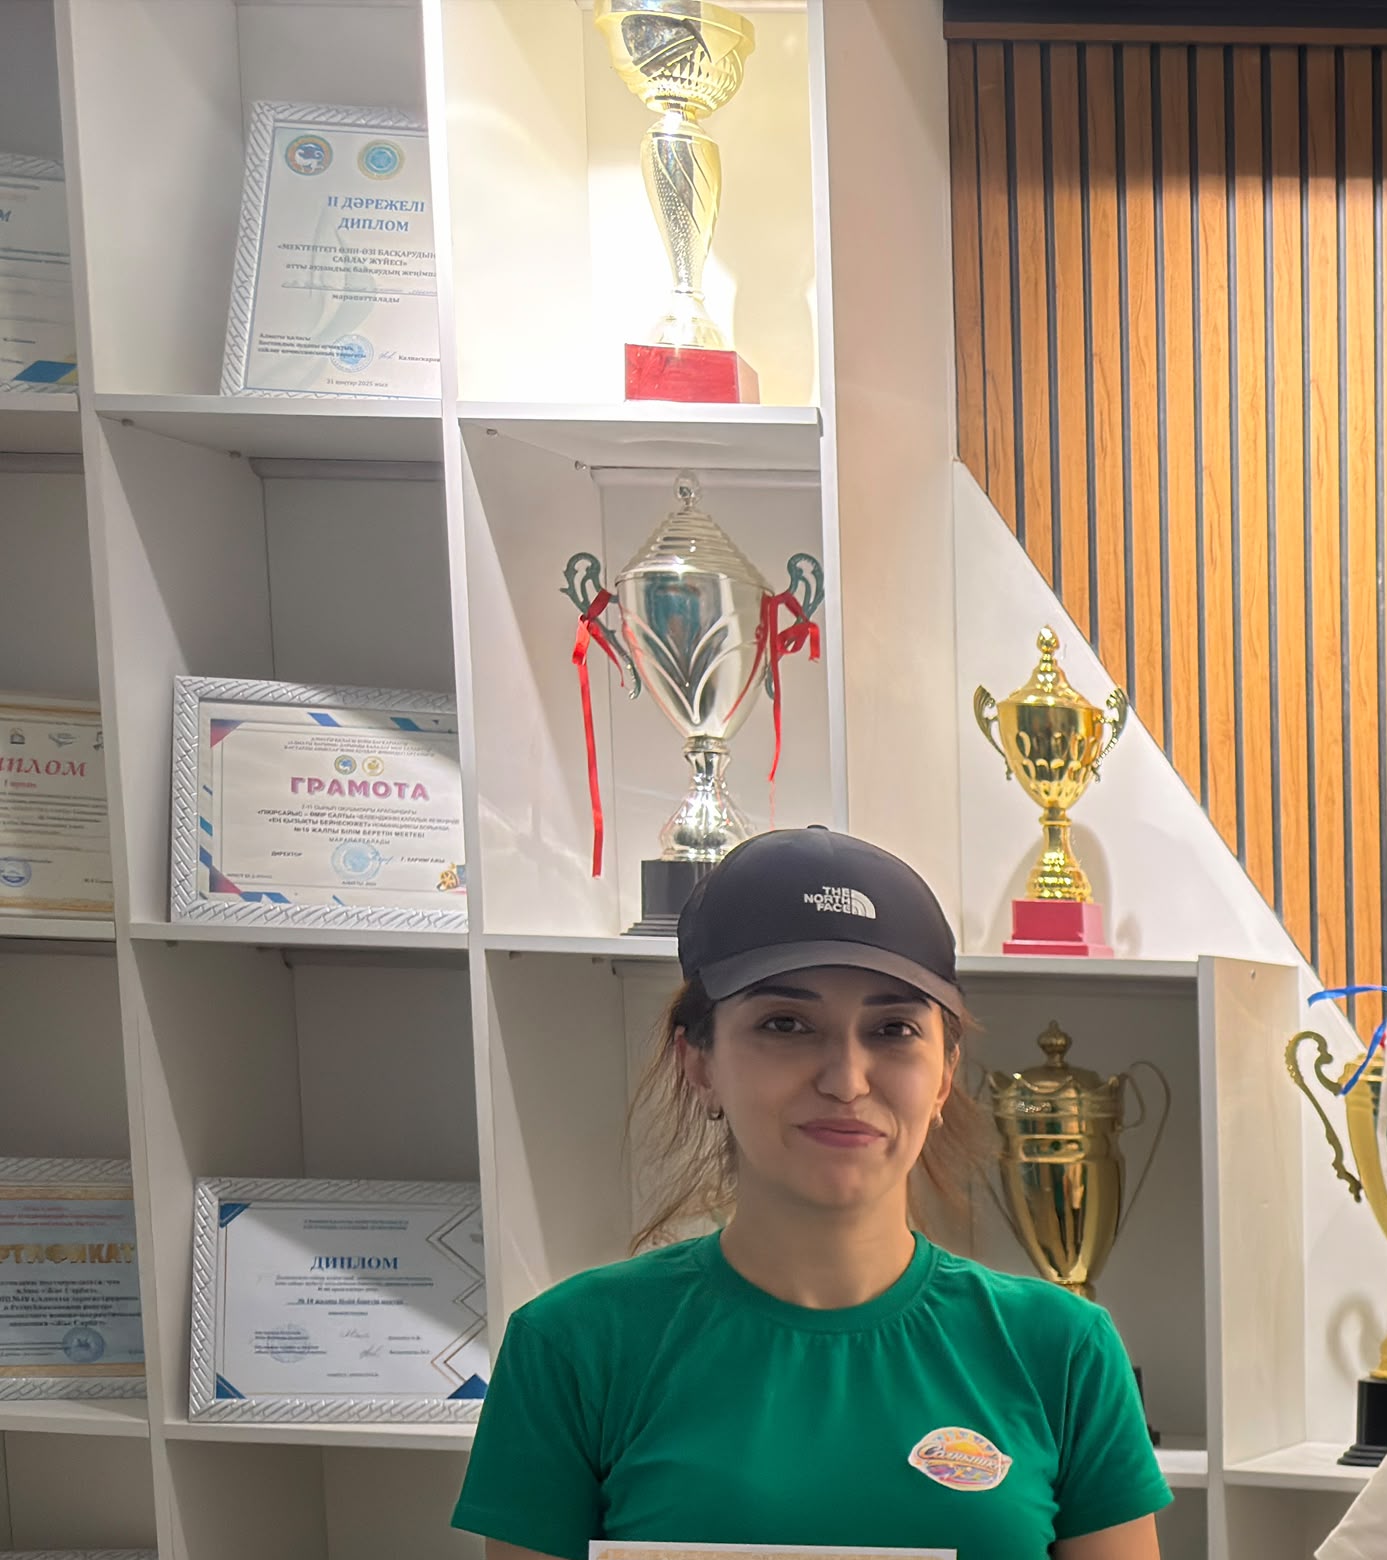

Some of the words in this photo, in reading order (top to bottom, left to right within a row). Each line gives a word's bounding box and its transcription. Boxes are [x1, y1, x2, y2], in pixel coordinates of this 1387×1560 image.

[341, 197, 425, 212] ДӘРЕЖЕЛІ
[337, 217, 409, 231] ДИПЛОМ
[290, 776, 430, 801] ГРАМОТА
[822, 886, 850, 896] THE
[804, 893, 850, 905] NORTH
[816, 903, 851, 914] FACE
[310, 1256, 398, 1271] ДИПЛОМ
